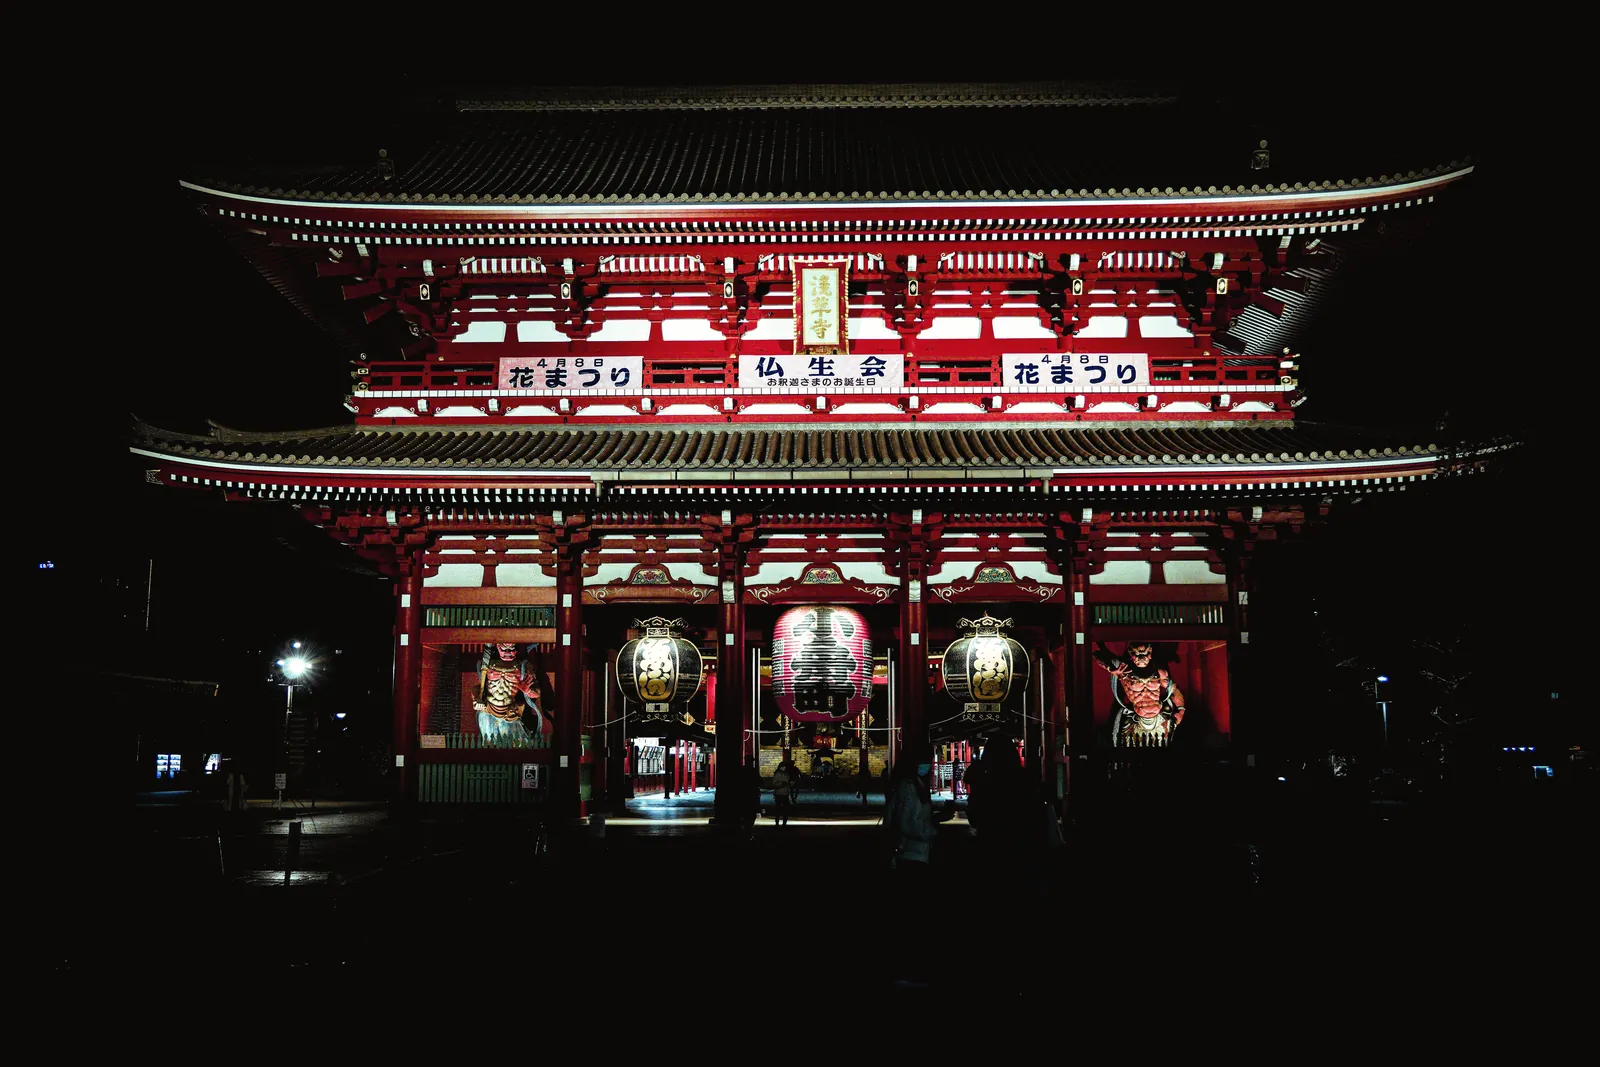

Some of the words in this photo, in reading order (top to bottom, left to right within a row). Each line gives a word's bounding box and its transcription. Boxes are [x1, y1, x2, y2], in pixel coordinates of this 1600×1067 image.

[537, 358, 604, 368] 4月8日
[755, 356, 887, 377] 仏生会
[1041, 354, 1109, 364] 4月8日
[509, 366, 630, 388] 花まつり
[1014, 363, 1137, 384] 花まつり
[767, 377, 876, 387] お釈迦さまのお誕生日
